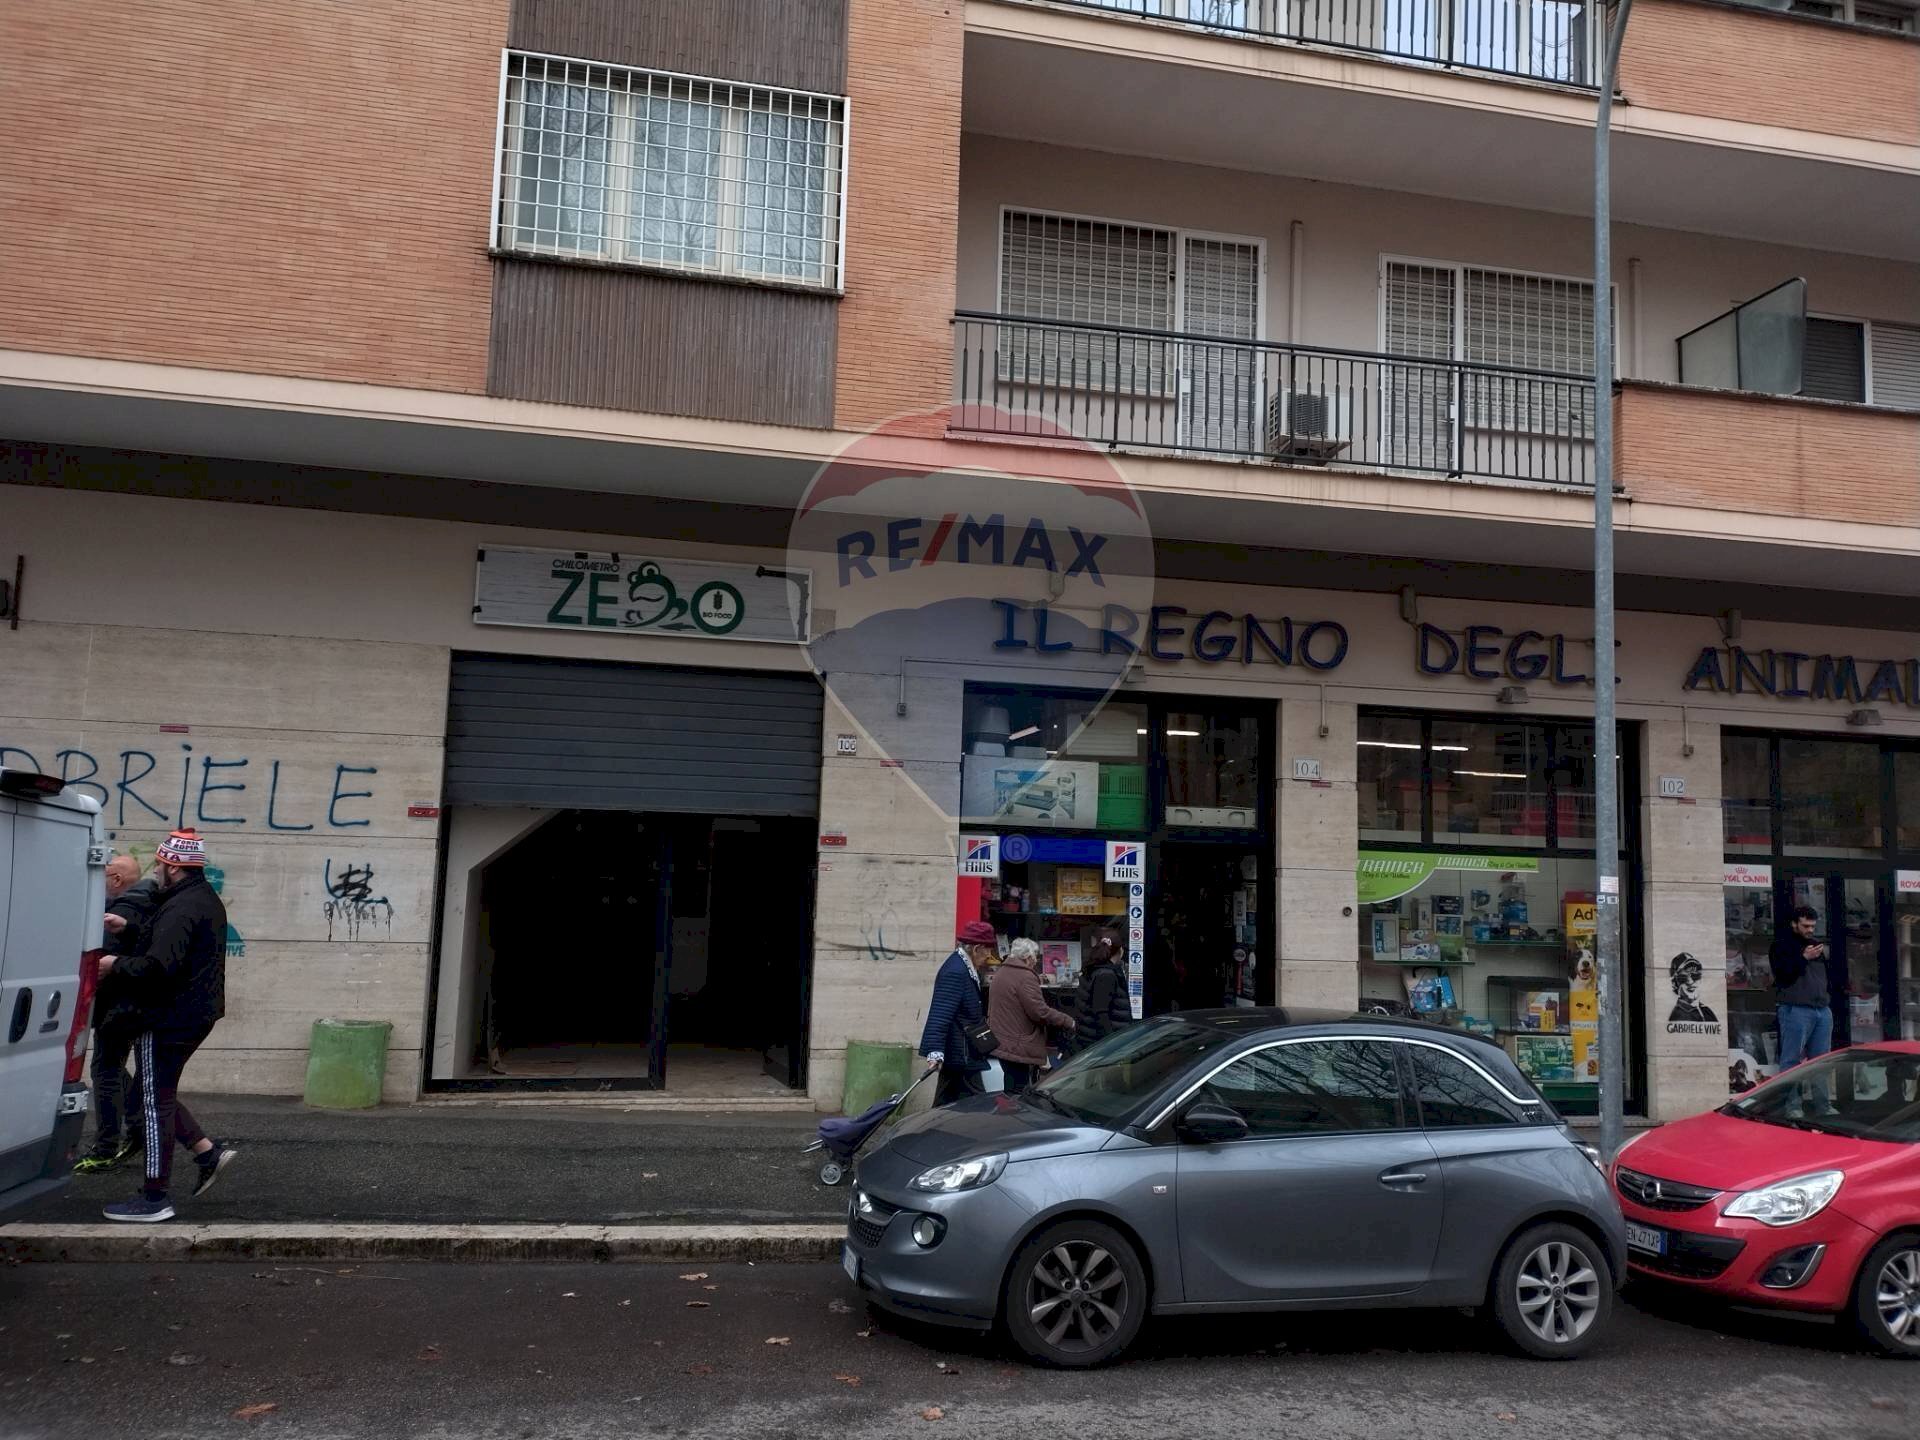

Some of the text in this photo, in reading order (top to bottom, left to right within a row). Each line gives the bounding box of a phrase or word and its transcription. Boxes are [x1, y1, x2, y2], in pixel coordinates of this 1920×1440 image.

[552, 559, 620, 573] CHILOMETRO
[993, 598, 1073, 654] IL
[1101, 603, 1349, 672] REGNO
[1295, 762, 1319, 776] 104
[1662, 779, 1684, 795] 102
[965, 860, 993, 873] Hill's
[1112, 866, 1139, 879] Hill's
[1742, 874, 1768, 884] CANIN
[226, 944, 246, 958] IVE
[1666, 1022, 1721, 1035] GABRIELE VIVE
